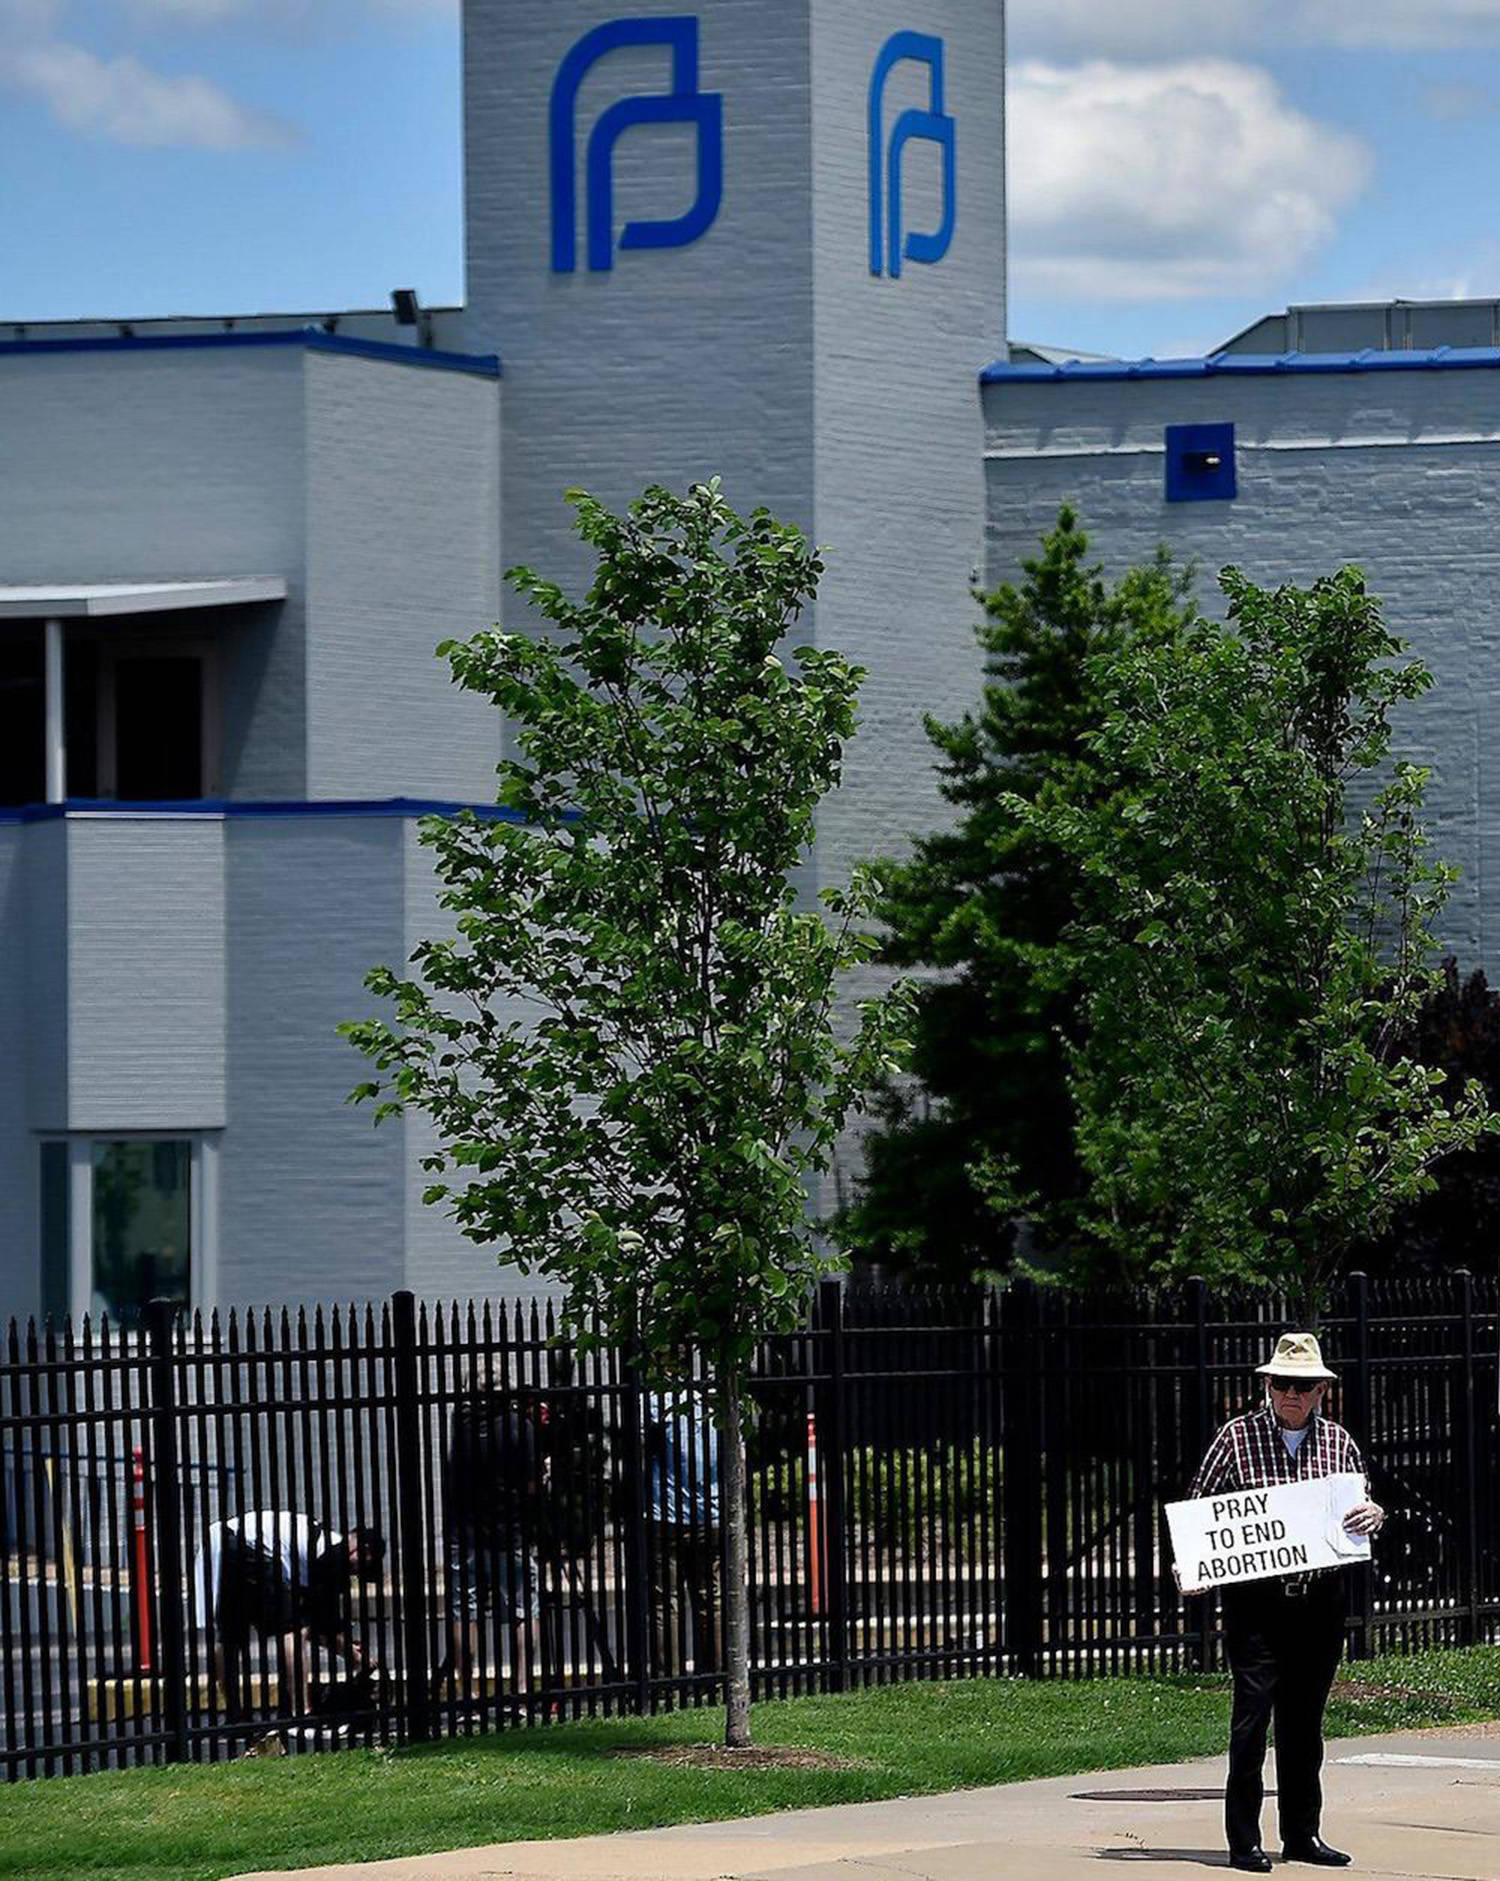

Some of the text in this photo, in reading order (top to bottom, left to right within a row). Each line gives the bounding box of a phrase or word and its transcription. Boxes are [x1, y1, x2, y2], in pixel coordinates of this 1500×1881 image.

[1212, 1493, 1268, 1522] PRAY
[1205, 1519, 1285, 1550] TO END
[1198, 1544, 1308, 1581] ABORTION
